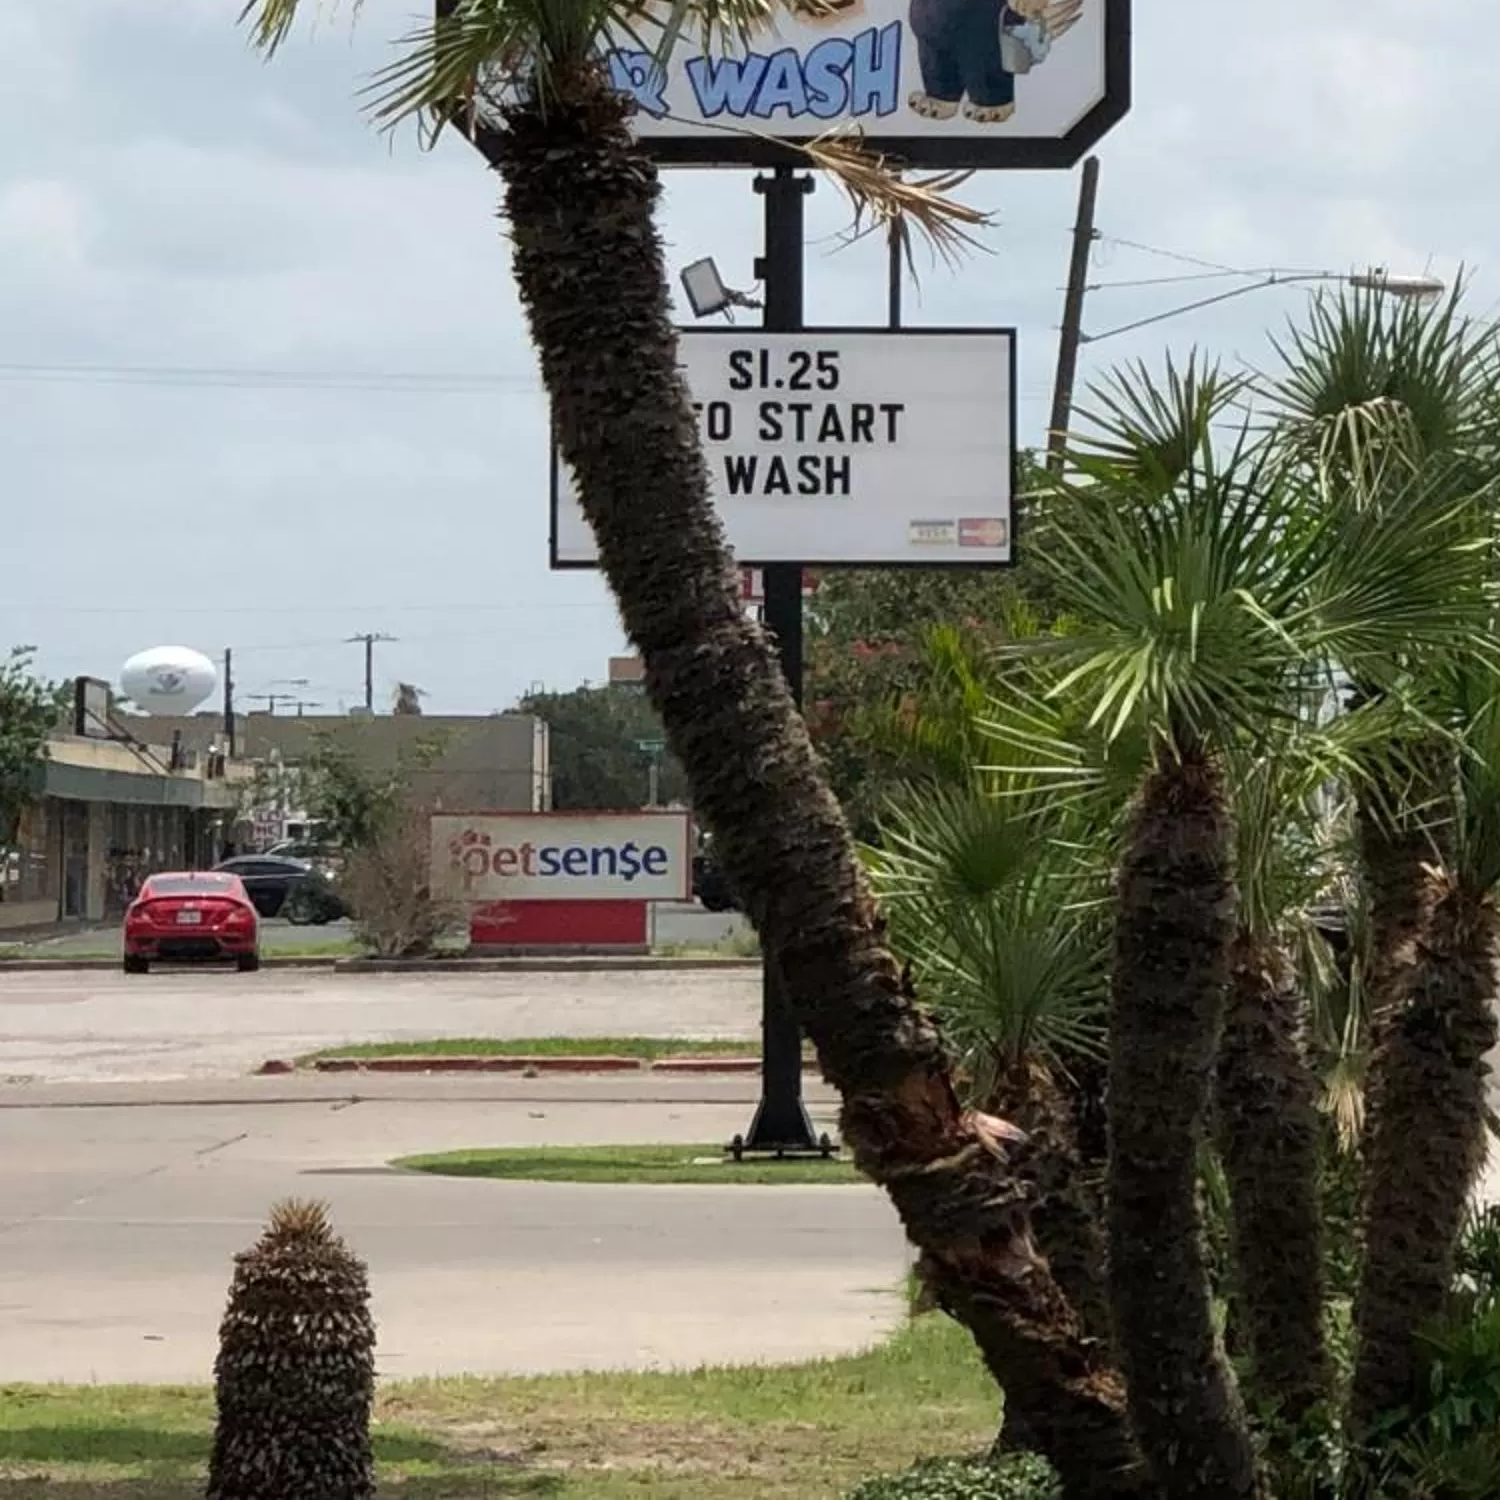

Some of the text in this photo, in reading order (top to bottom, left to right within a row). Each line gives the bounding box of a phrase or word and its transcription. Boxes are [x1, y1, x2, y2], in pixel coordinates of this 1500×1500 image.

[685, 21, 902, 118] WASH
[691, 401, 905, 443] O START
[723, 455, 851, 495] WASH
